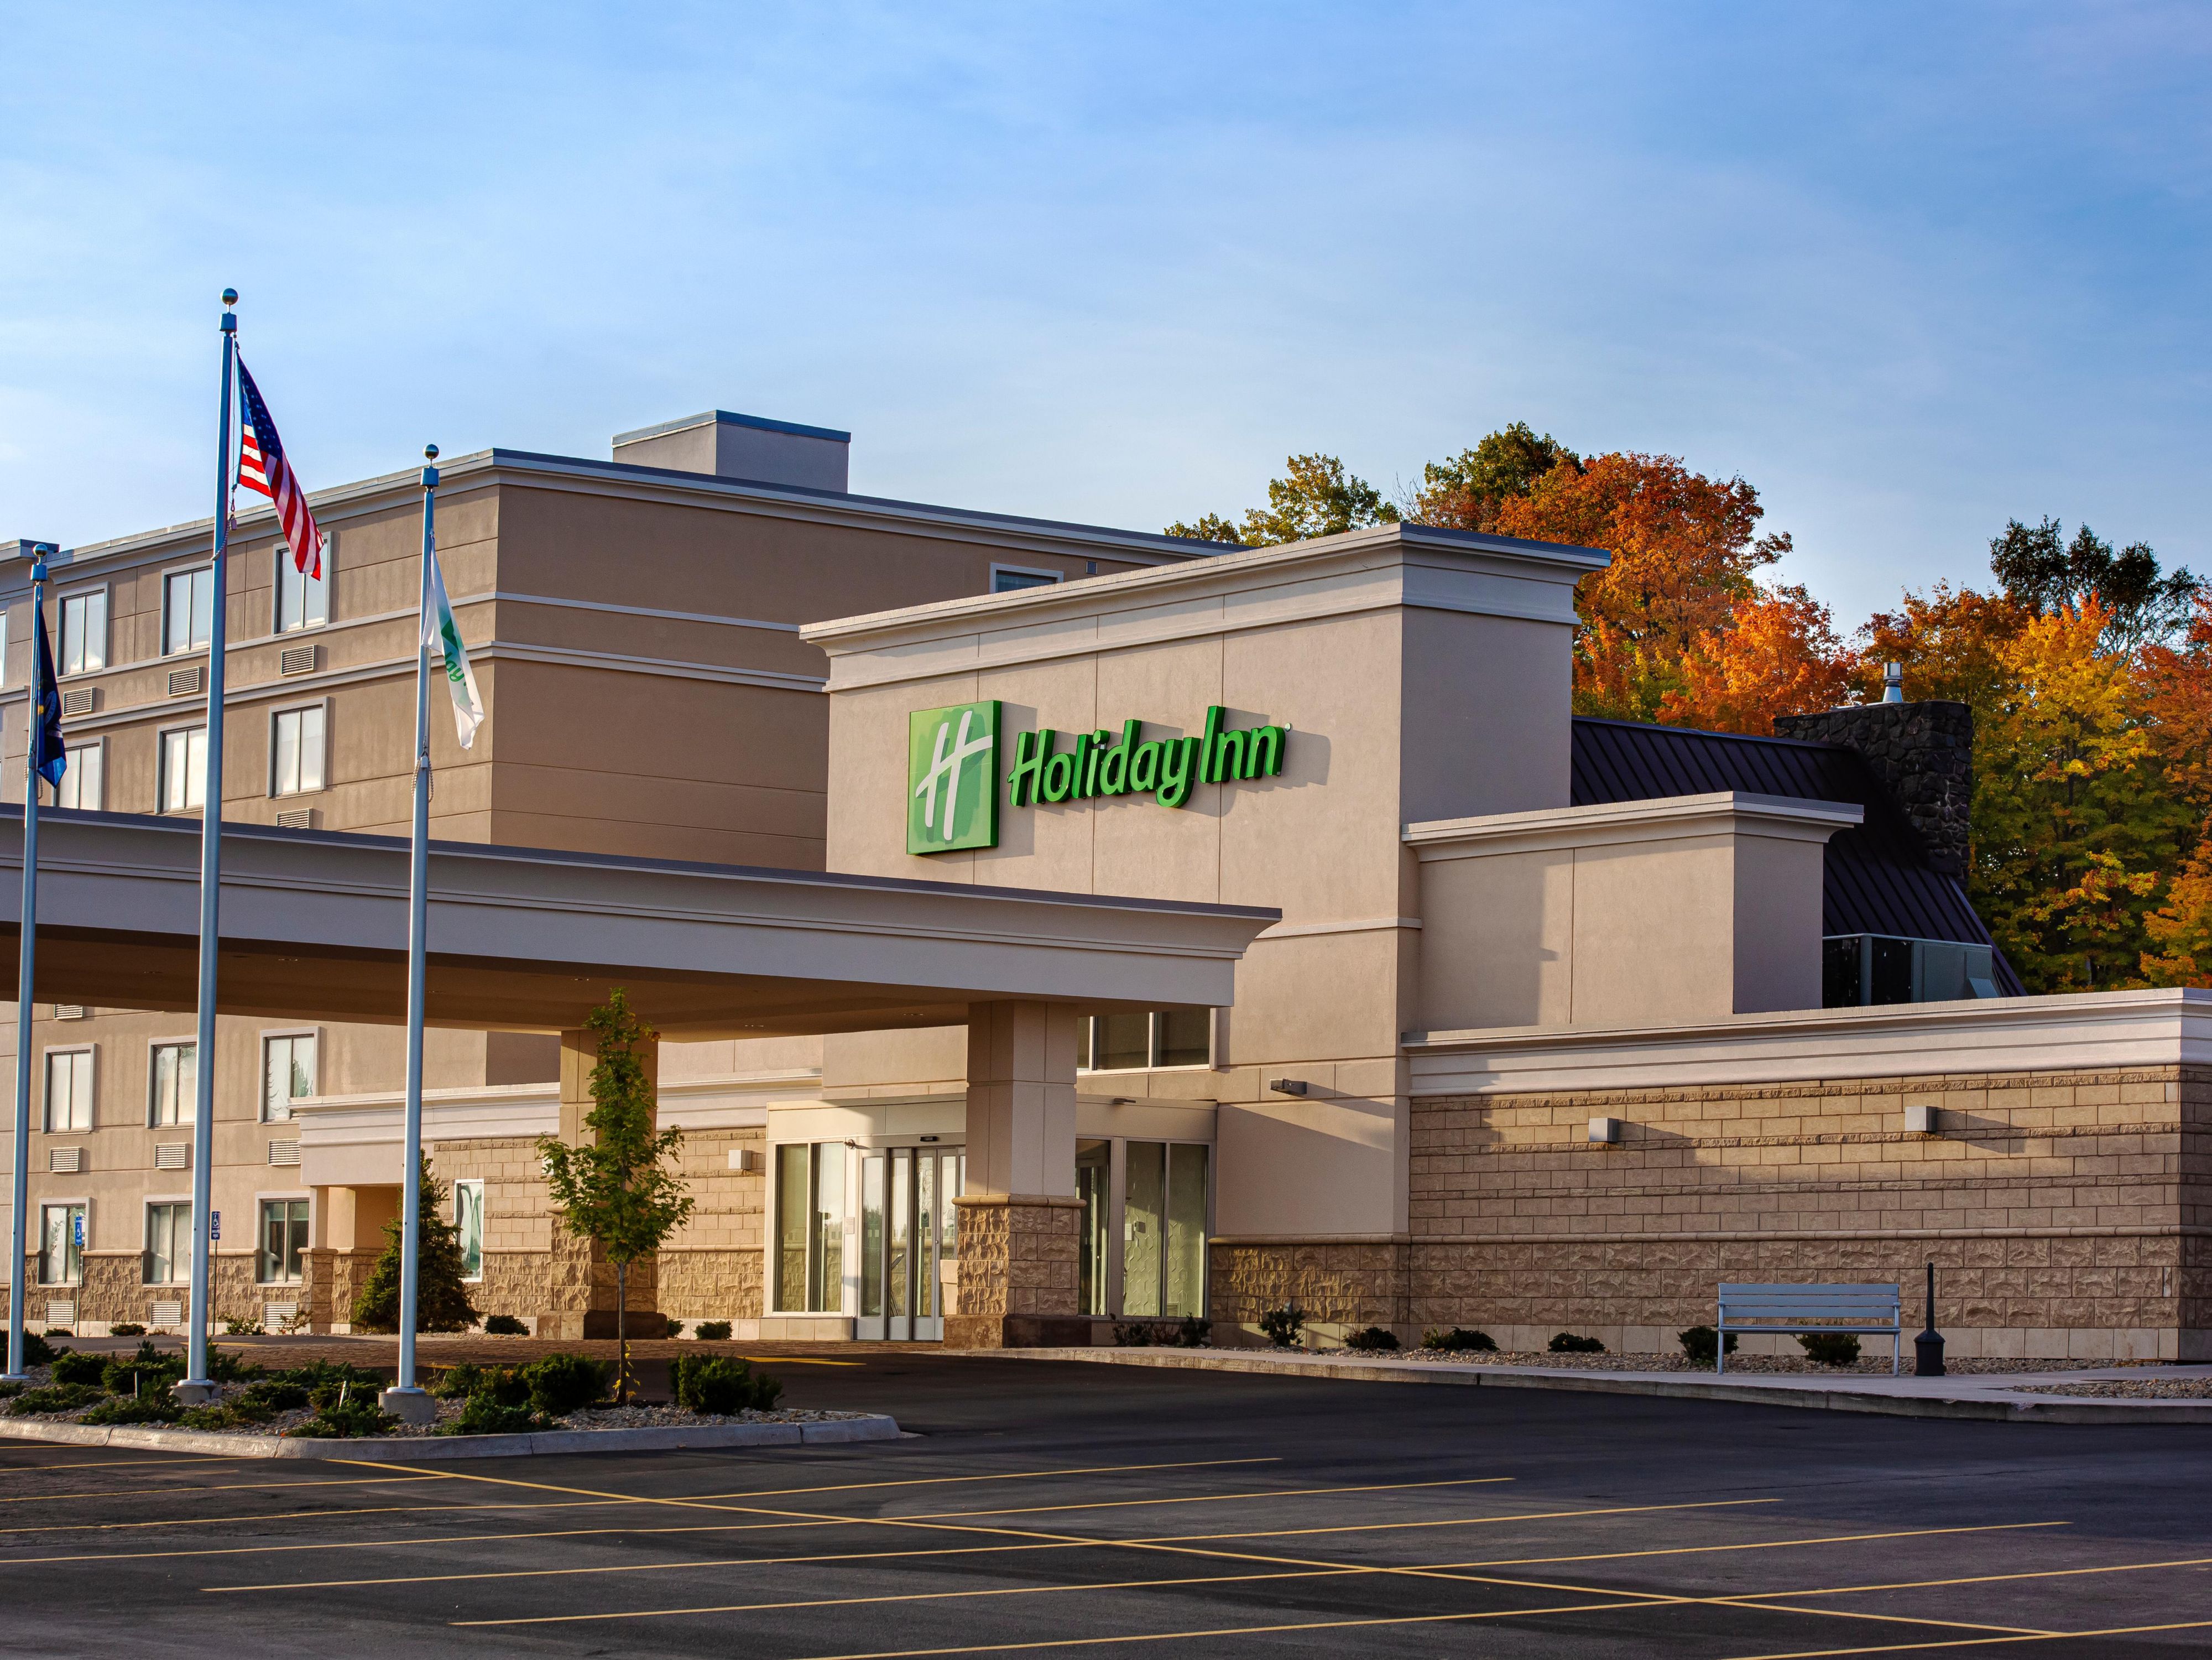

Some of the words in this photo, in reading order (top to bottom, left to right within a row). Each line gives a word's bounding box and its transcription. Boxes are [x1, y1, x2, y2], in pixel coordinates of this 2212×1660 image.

[915, 710, 993, 841] H
[1008, 720, 1200, 807] Holiday
[1198, 706, 1286, 784] Inn
